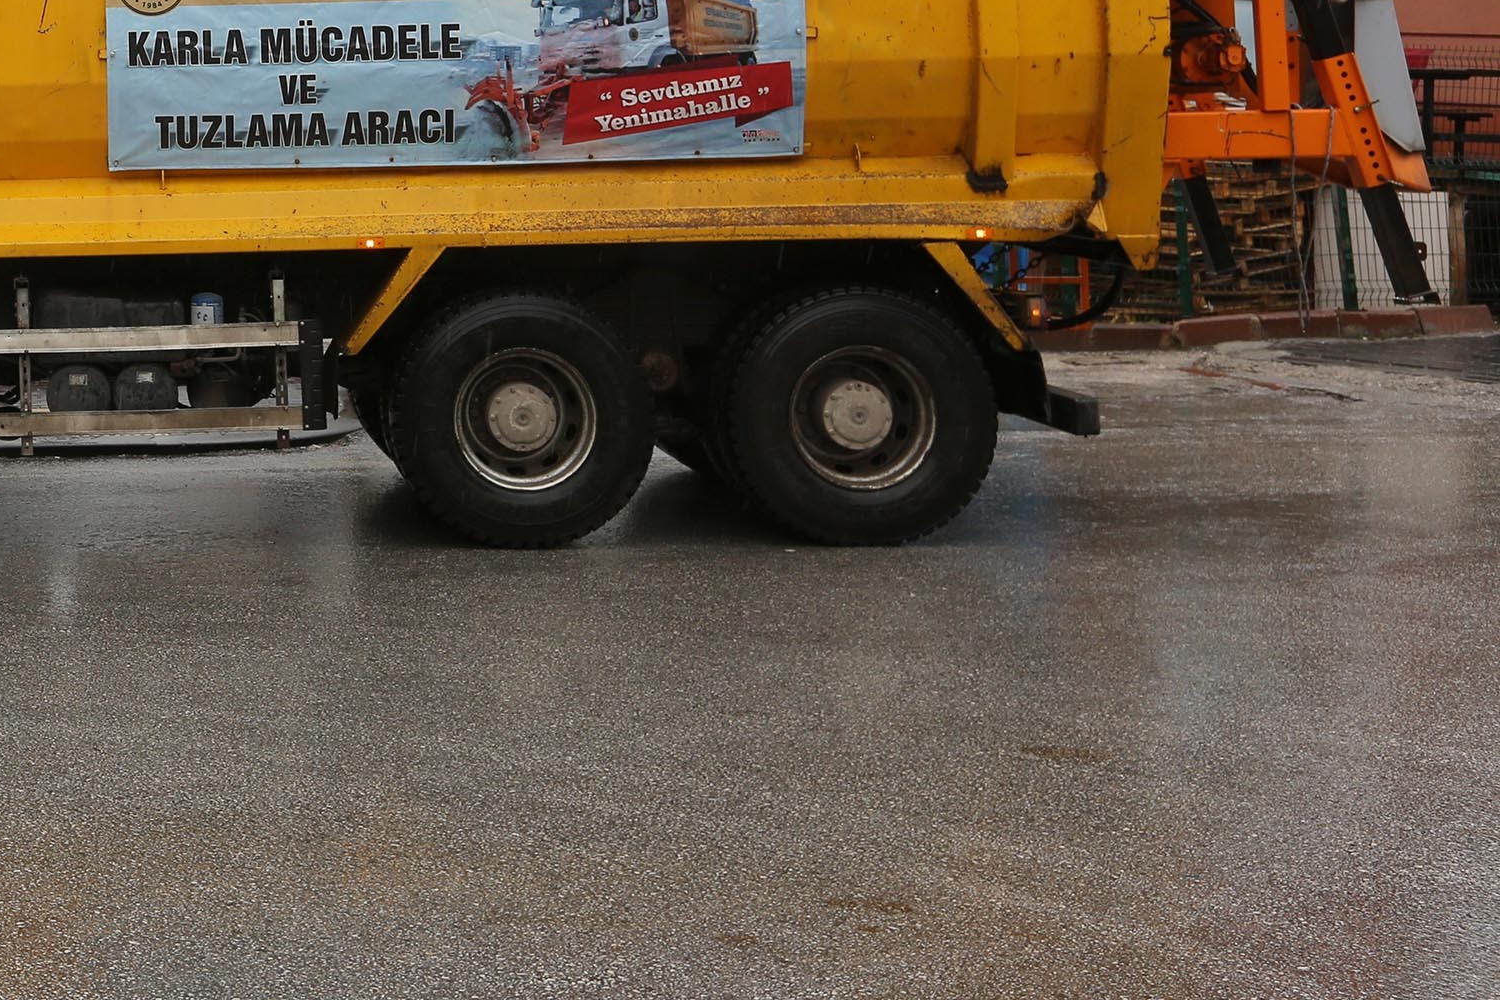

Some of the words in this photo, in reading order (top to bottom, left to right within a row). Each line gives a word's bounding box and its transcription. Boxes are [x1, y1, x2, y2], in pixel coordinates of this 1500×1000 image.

[142, 1, 163, 9] 1984
[127, 28, 249, 67] KARLA
[259, 19, 463, 64] MÜCADELE
[278, 73, 318, 106] VE
[620, 75, 743, 107] Sevdamız
[154, 112, 331, 150] TUZLAMA
[341, 109, 457, 147] ARACI
[594, 94, 751, 132] Yenimahalle
